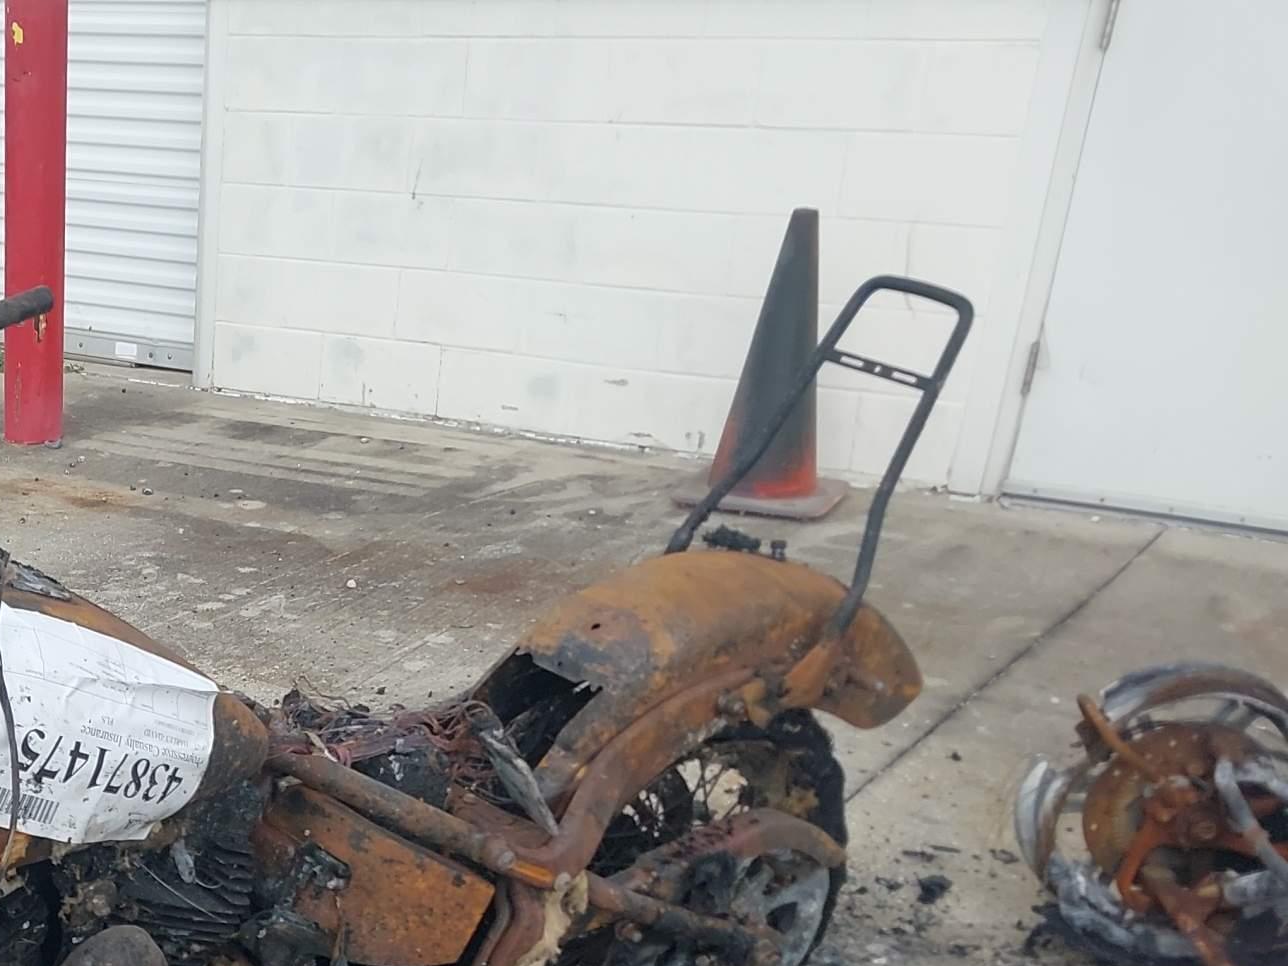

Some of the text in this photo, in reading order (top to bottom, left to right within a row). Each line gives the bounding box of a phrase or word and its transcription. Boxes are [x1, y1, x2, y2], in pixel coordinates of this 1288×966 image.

[80, 724, 122, 748] Insurance
[126, 735, 160, 758] Casualty
[18, 728, 184, 804] 43871475
